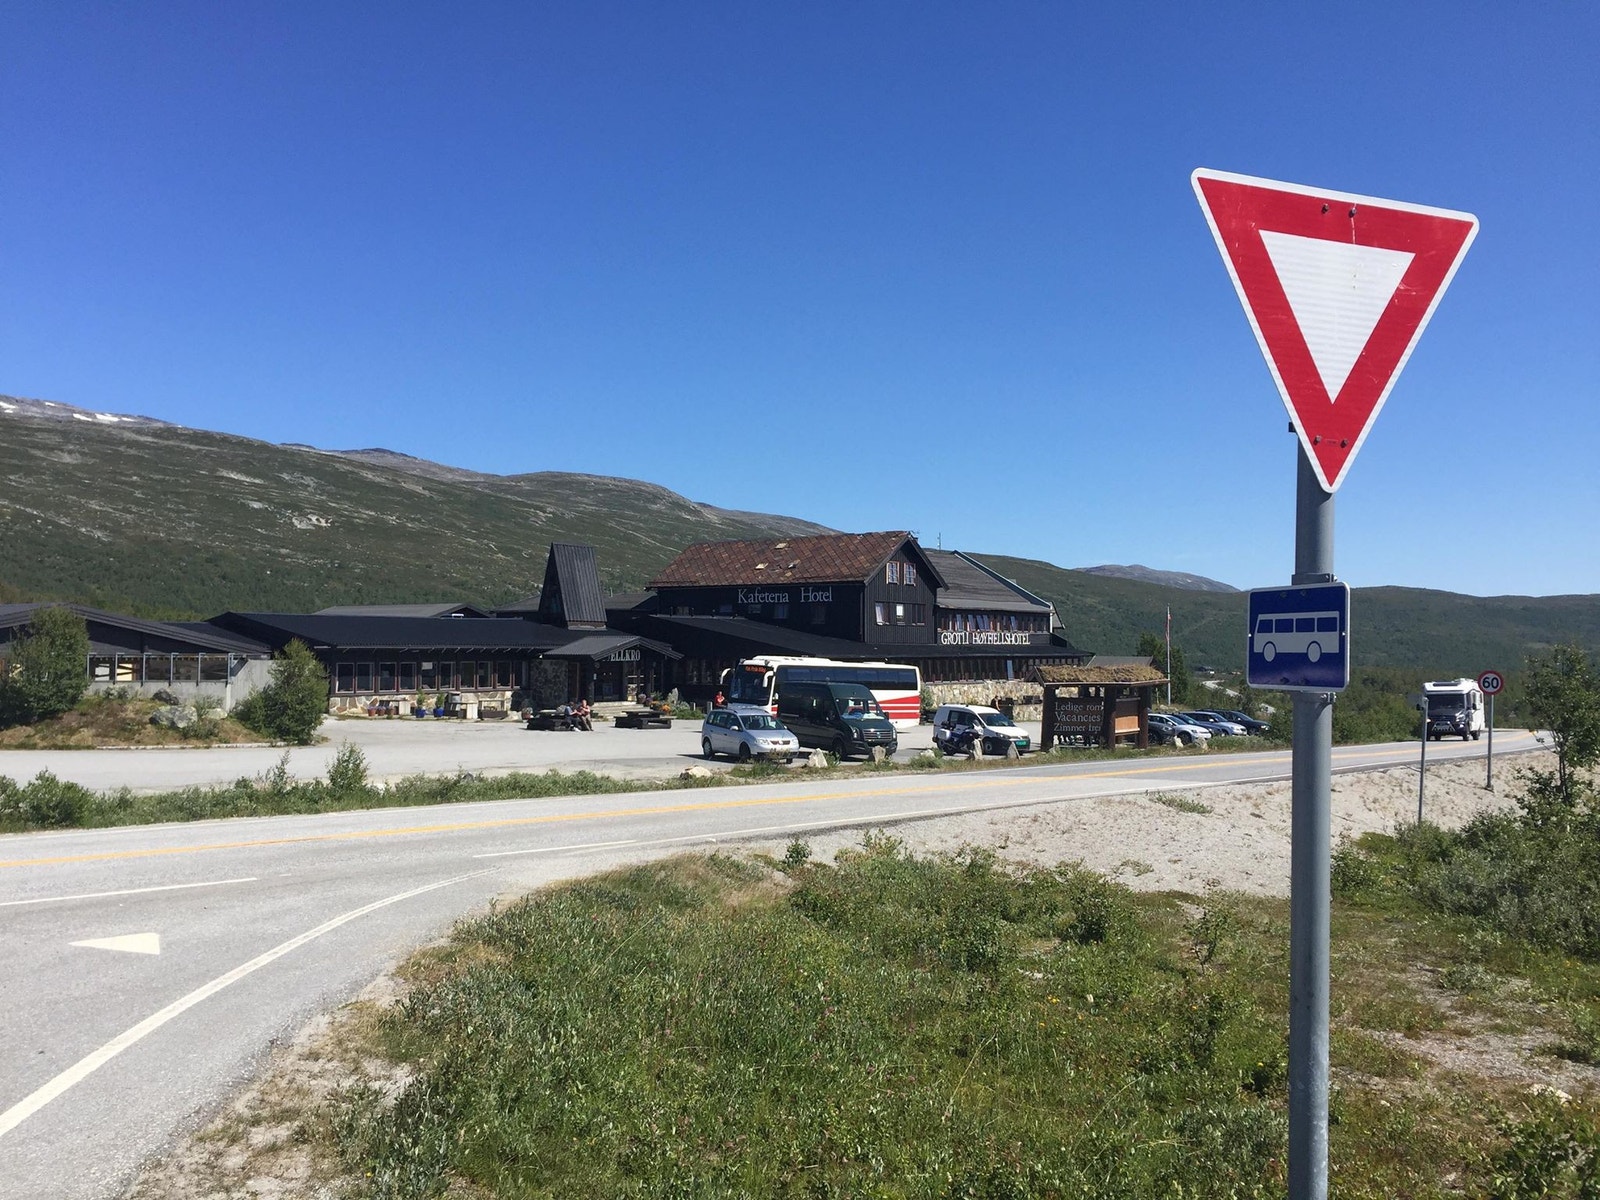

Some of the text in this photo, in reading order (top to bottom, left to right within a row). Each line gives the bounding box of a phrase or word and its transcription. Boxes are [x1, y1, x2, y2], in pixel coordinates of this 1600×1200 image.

[738, 586, 833, 604] Kafeteria Hotel
[941, 631, 969, 645] GROTLI
[603, 649, 641, 662] ELLKRO
[1482, 676, 1499, 689] 60
[1055, 701, 1084, 713] Ledige
[1054, 711, 1101, 722] Vacancies
[1053, 722, 1086, 732] Zimmer
